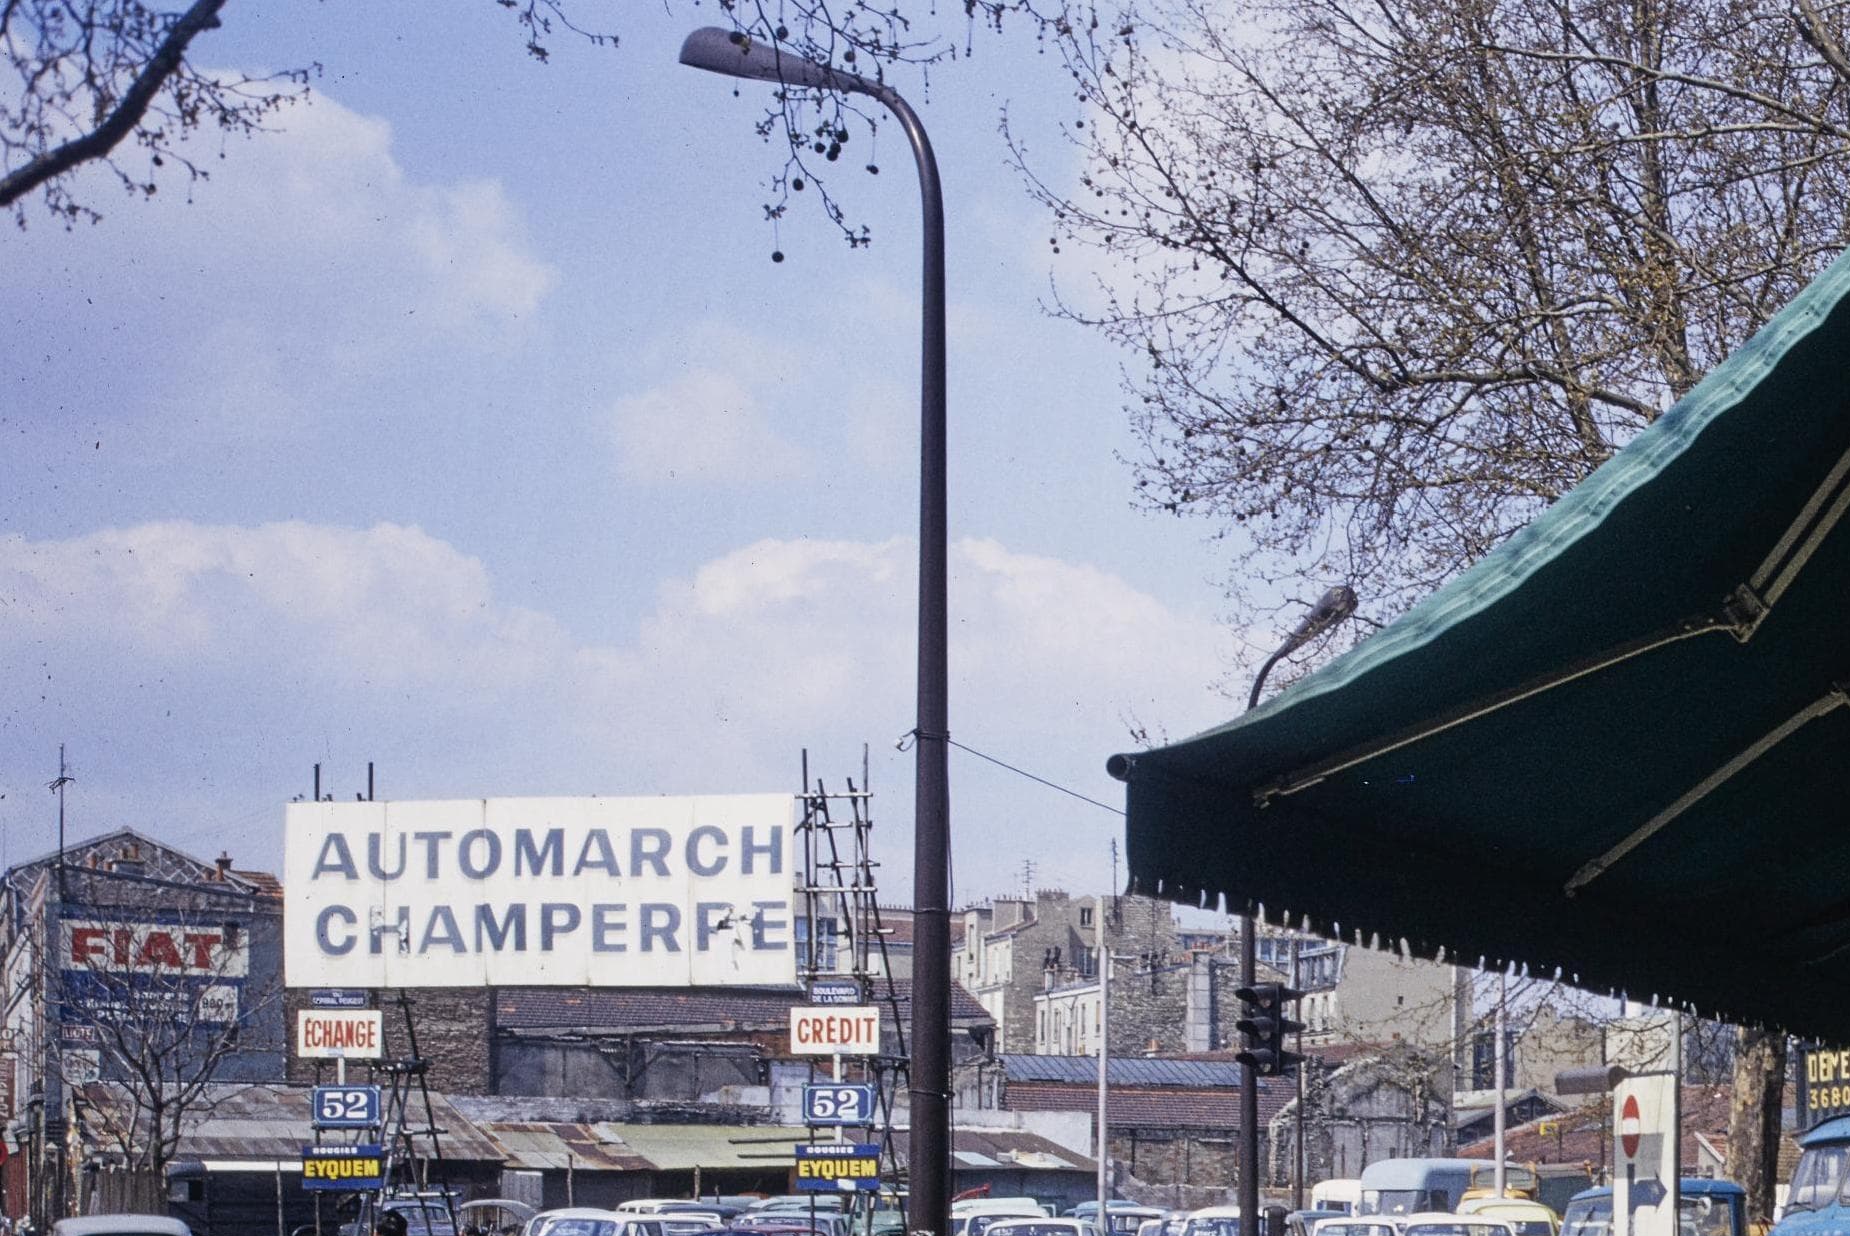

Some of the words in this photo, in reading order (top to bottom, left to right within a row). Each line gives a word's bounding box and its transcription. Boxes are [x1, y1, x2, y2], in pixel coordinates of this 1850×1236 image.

[312, 825, 784, 881] AUTOMARCH
[72, 927, 221, 969] FIAT
[304, 1017, 376, 1048] ÉCHANGE
[797, 1015, 876, 1044] CRÉDIT
[322, 1091, 368, 1118] 52
[813, 1089, 859, 1118] 52
[304, 1160, 379, 1180] EYQUEM
[798, 1160, 877, 1180] EYQUEM
